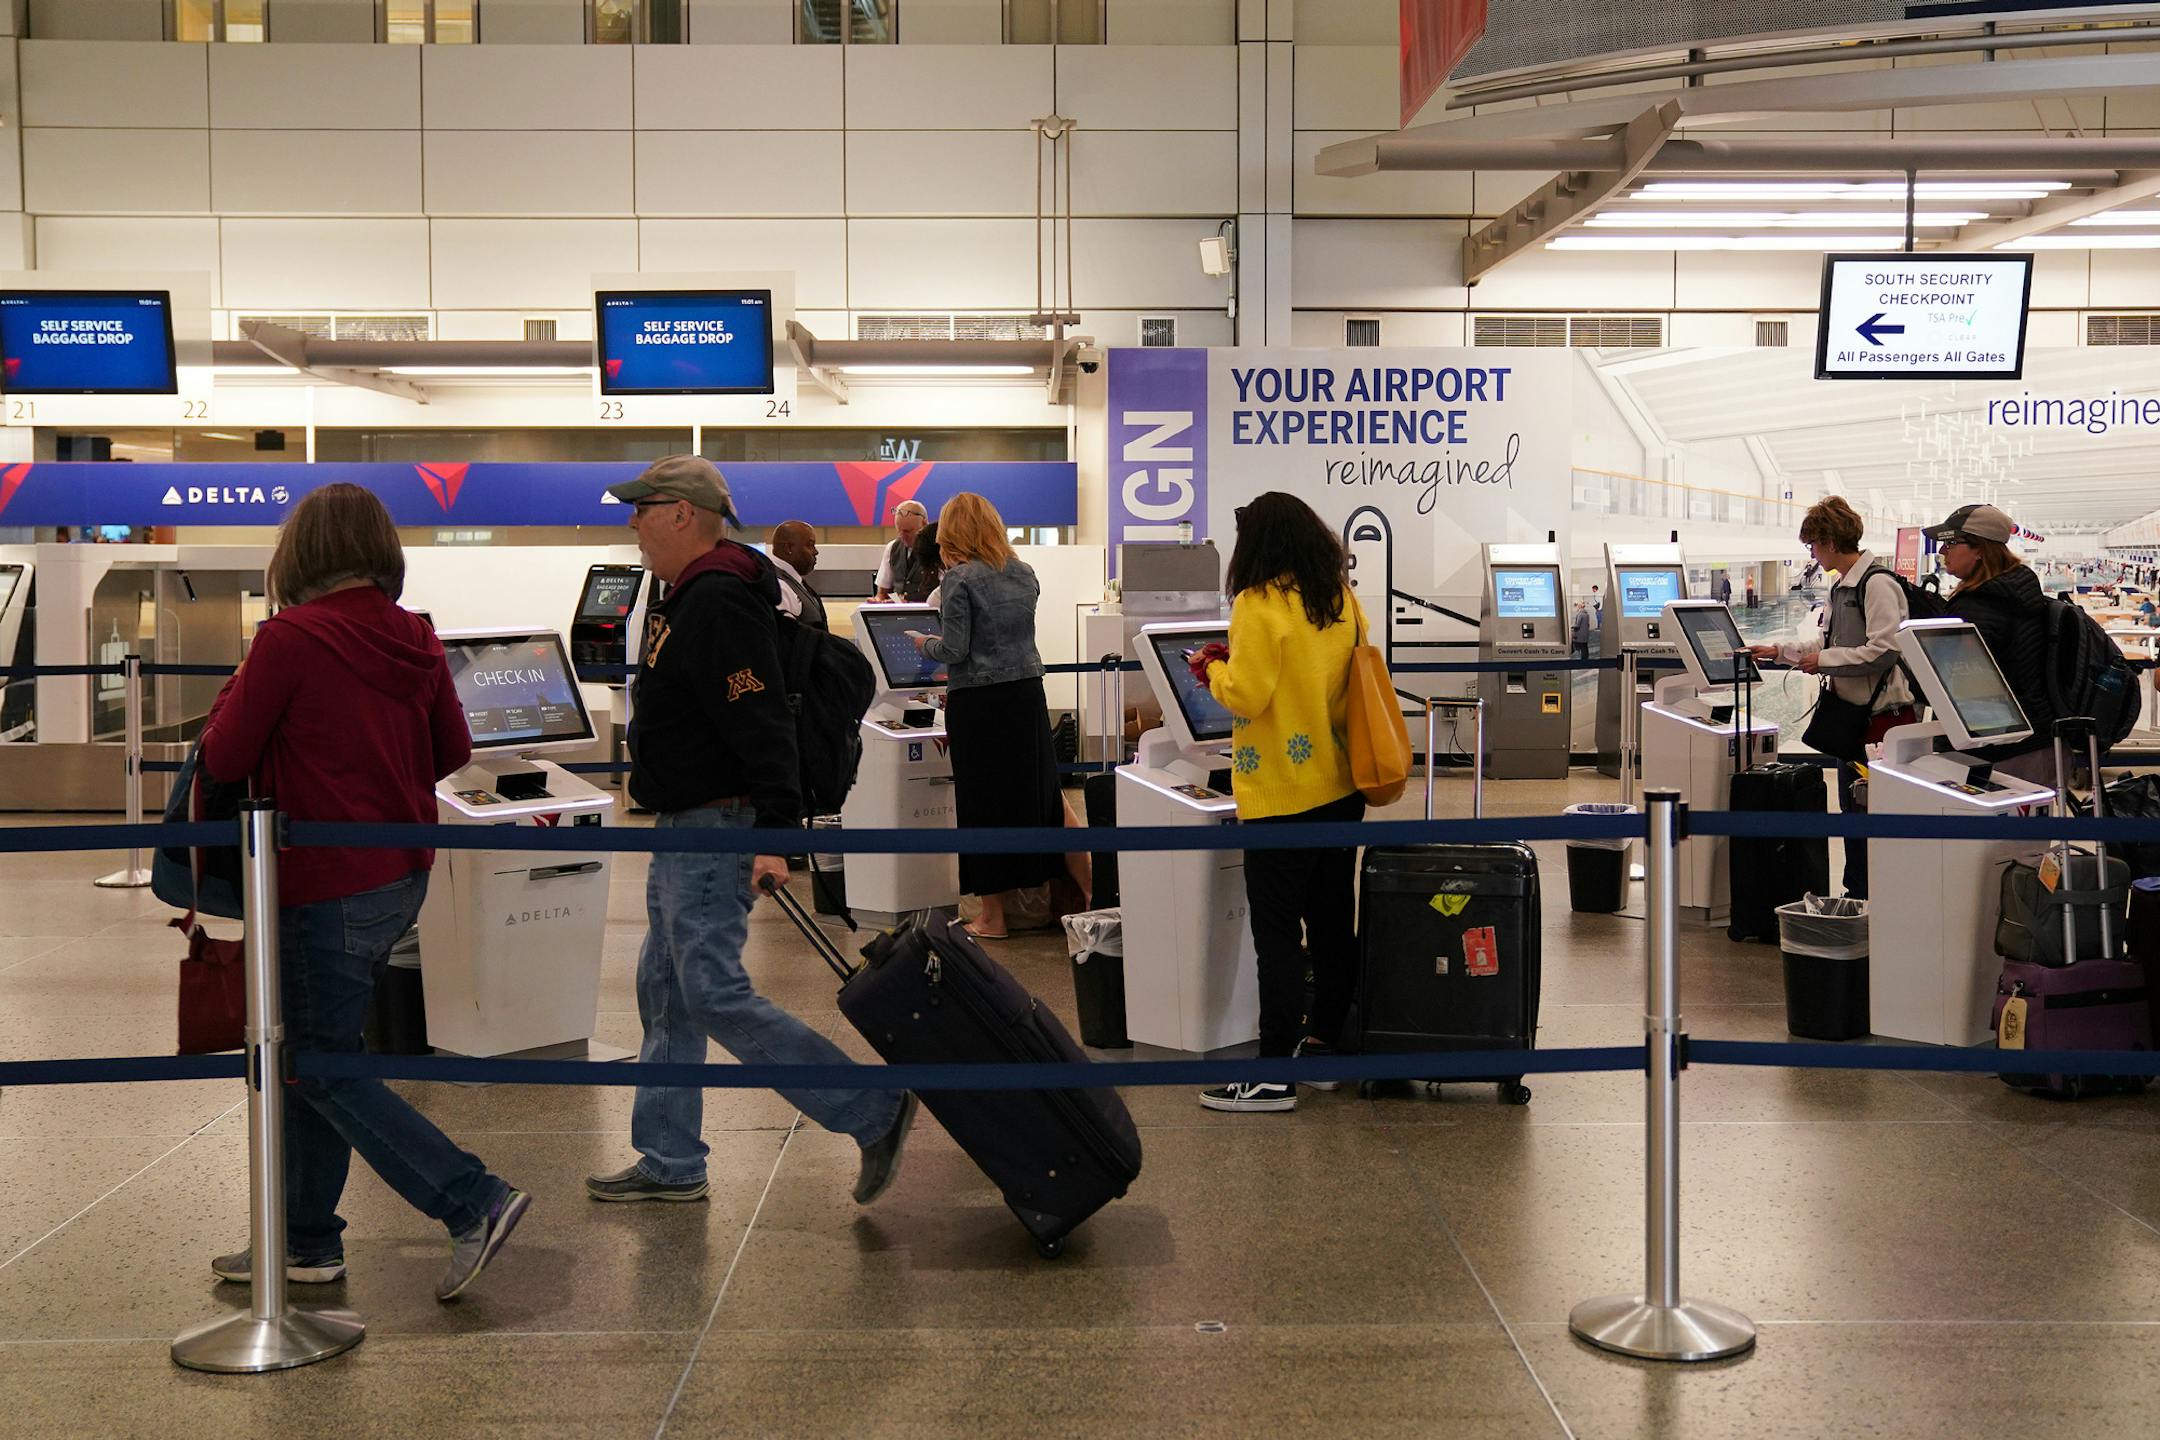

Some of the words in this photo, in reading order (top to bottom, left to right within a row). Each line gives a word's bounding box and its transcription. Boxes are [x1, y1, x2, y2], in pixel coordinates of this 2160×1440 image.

[1864, 274, 1914, 286] SOUTH
[1920, 274, 1993, 285] SECURITY
[1879, 293, 1975, 305] CHECKPOINT
[41, 320, 69, 331] SELF
[71, 320, 123, 331] SERVICE
[644, 321, 671, 332] SELF
[673, 321, 724, 331] SERVICE
[1928, 313, 1946, 323] TSA
[1949, 313, 1965, 323] Pre
[32, 333, 96, 344] BAGGAGE
[98, 333, 133, 344] DROP
[635, 334, 696, 344] BAGGAGE
[699, 333, 733, 344] DROP
[1837, 352, 1855, 363] All
[1859, 351, 1939, 365] Passengers
[1944, 351, 1962, 362] All
[1966, 351, 2006, 362] Gates
[1231, 368, 1336, 402] YOUR
[1345, 368, 1511, 401] AIRPORT
[13, 401, 35, 419] 21
[183, 400, 208, 418] 22
[600, 401, 624, 419] 23
[765, 400, 791, 418] 24
[1988, 391, 2160, 434] reimagine
[1233, 410, 1467, 445] EXPERIENCE
[1325, 433, 1520, 515] reimagined
[188, 487, 266, 504] DELTA
[473, 670, 527, 686] CHECK
[527, 668, 545, 683] IN
[521, 907, 571, 922] DELTA
